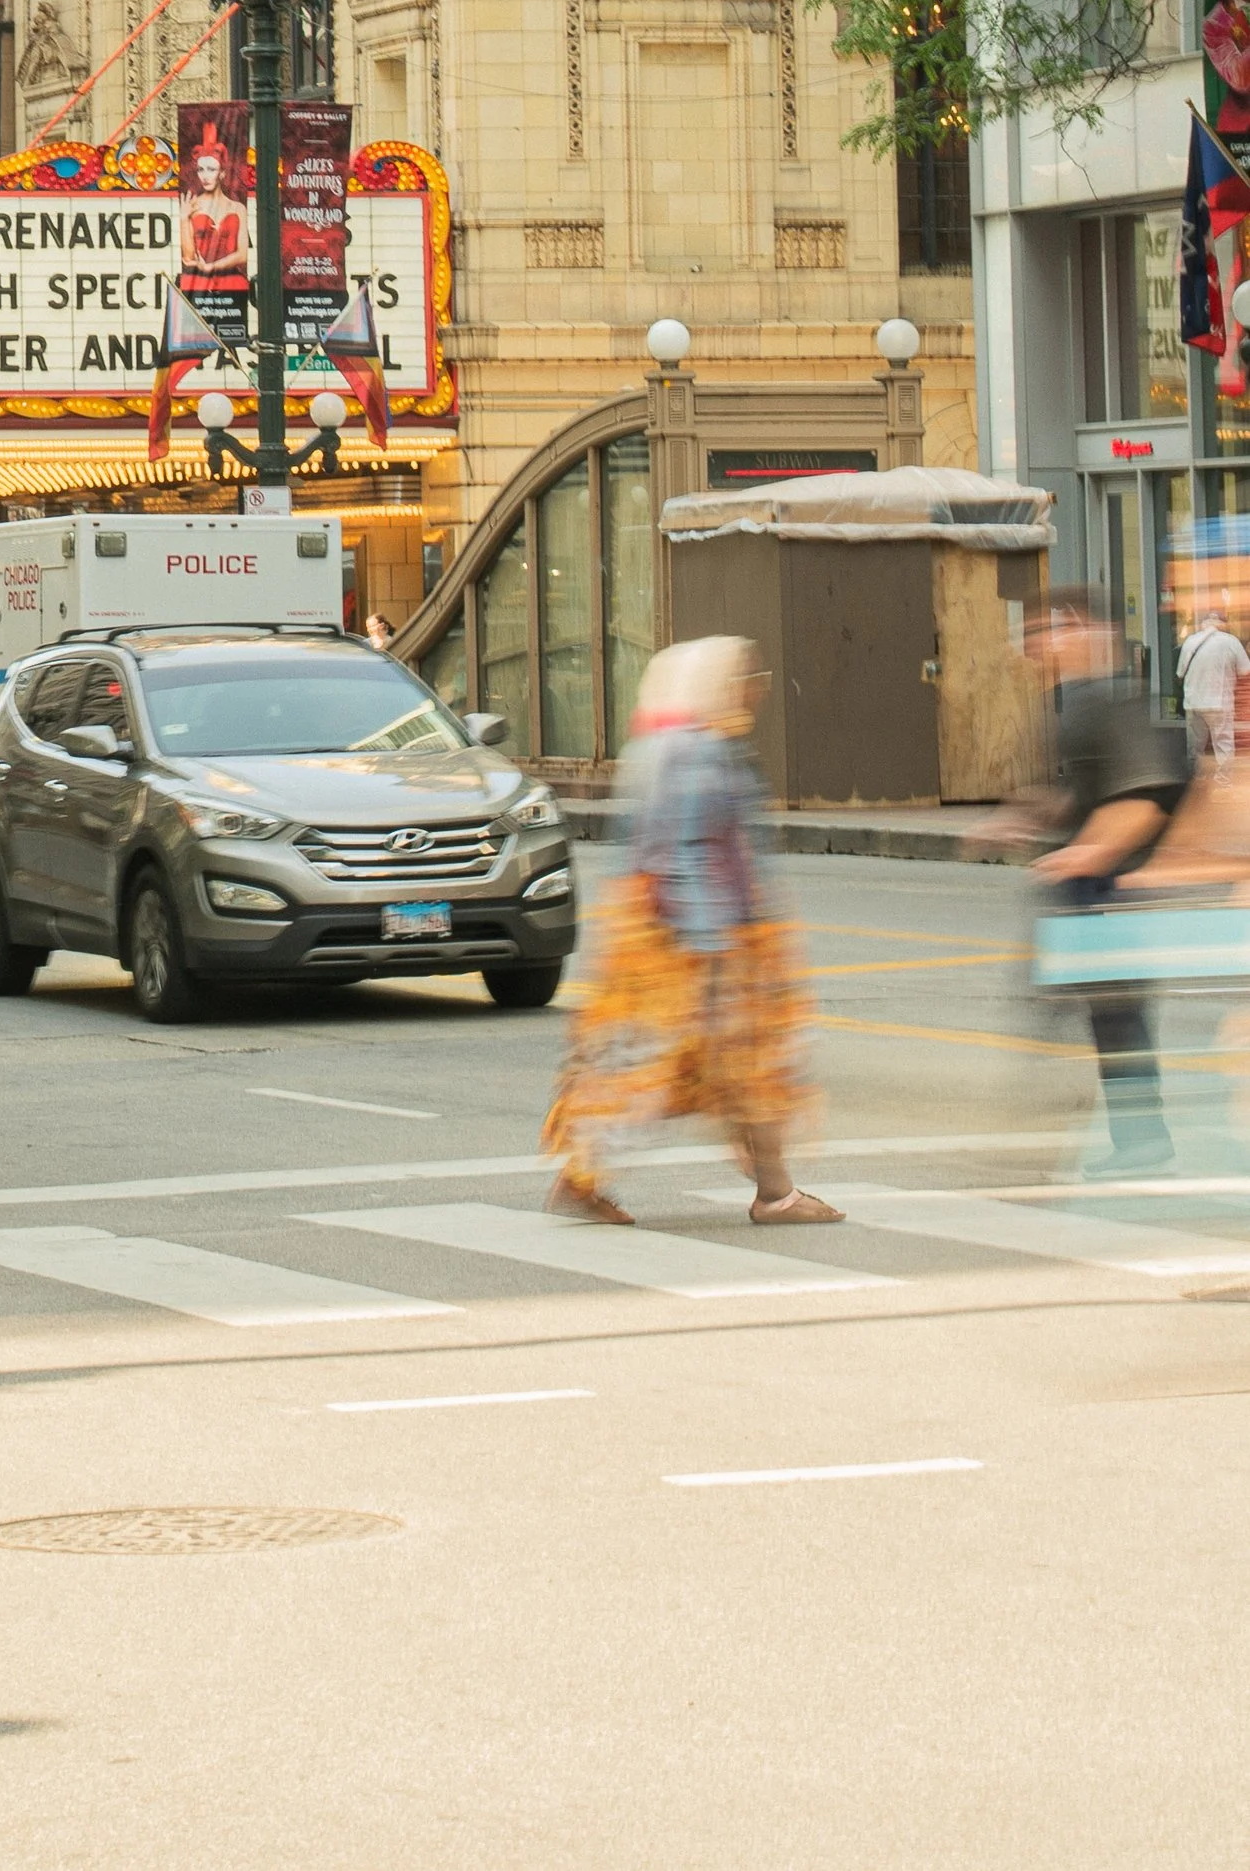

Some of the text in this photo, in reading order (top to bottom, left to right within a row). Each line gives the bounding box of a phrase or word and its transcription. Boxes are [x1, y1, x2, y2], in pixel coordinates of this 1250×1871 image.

[308, 191, 320, 206] IN
[283, 207, 344, 232] WONDERLAND
[79, 334, 159, 372] AND
[755, 453, 822, 469] SUBWAY
[166, 554, 258, 575] POLICE
[4, 564, 40, 587] CHICAGO
[7, 590, 36, 611] POLICE
